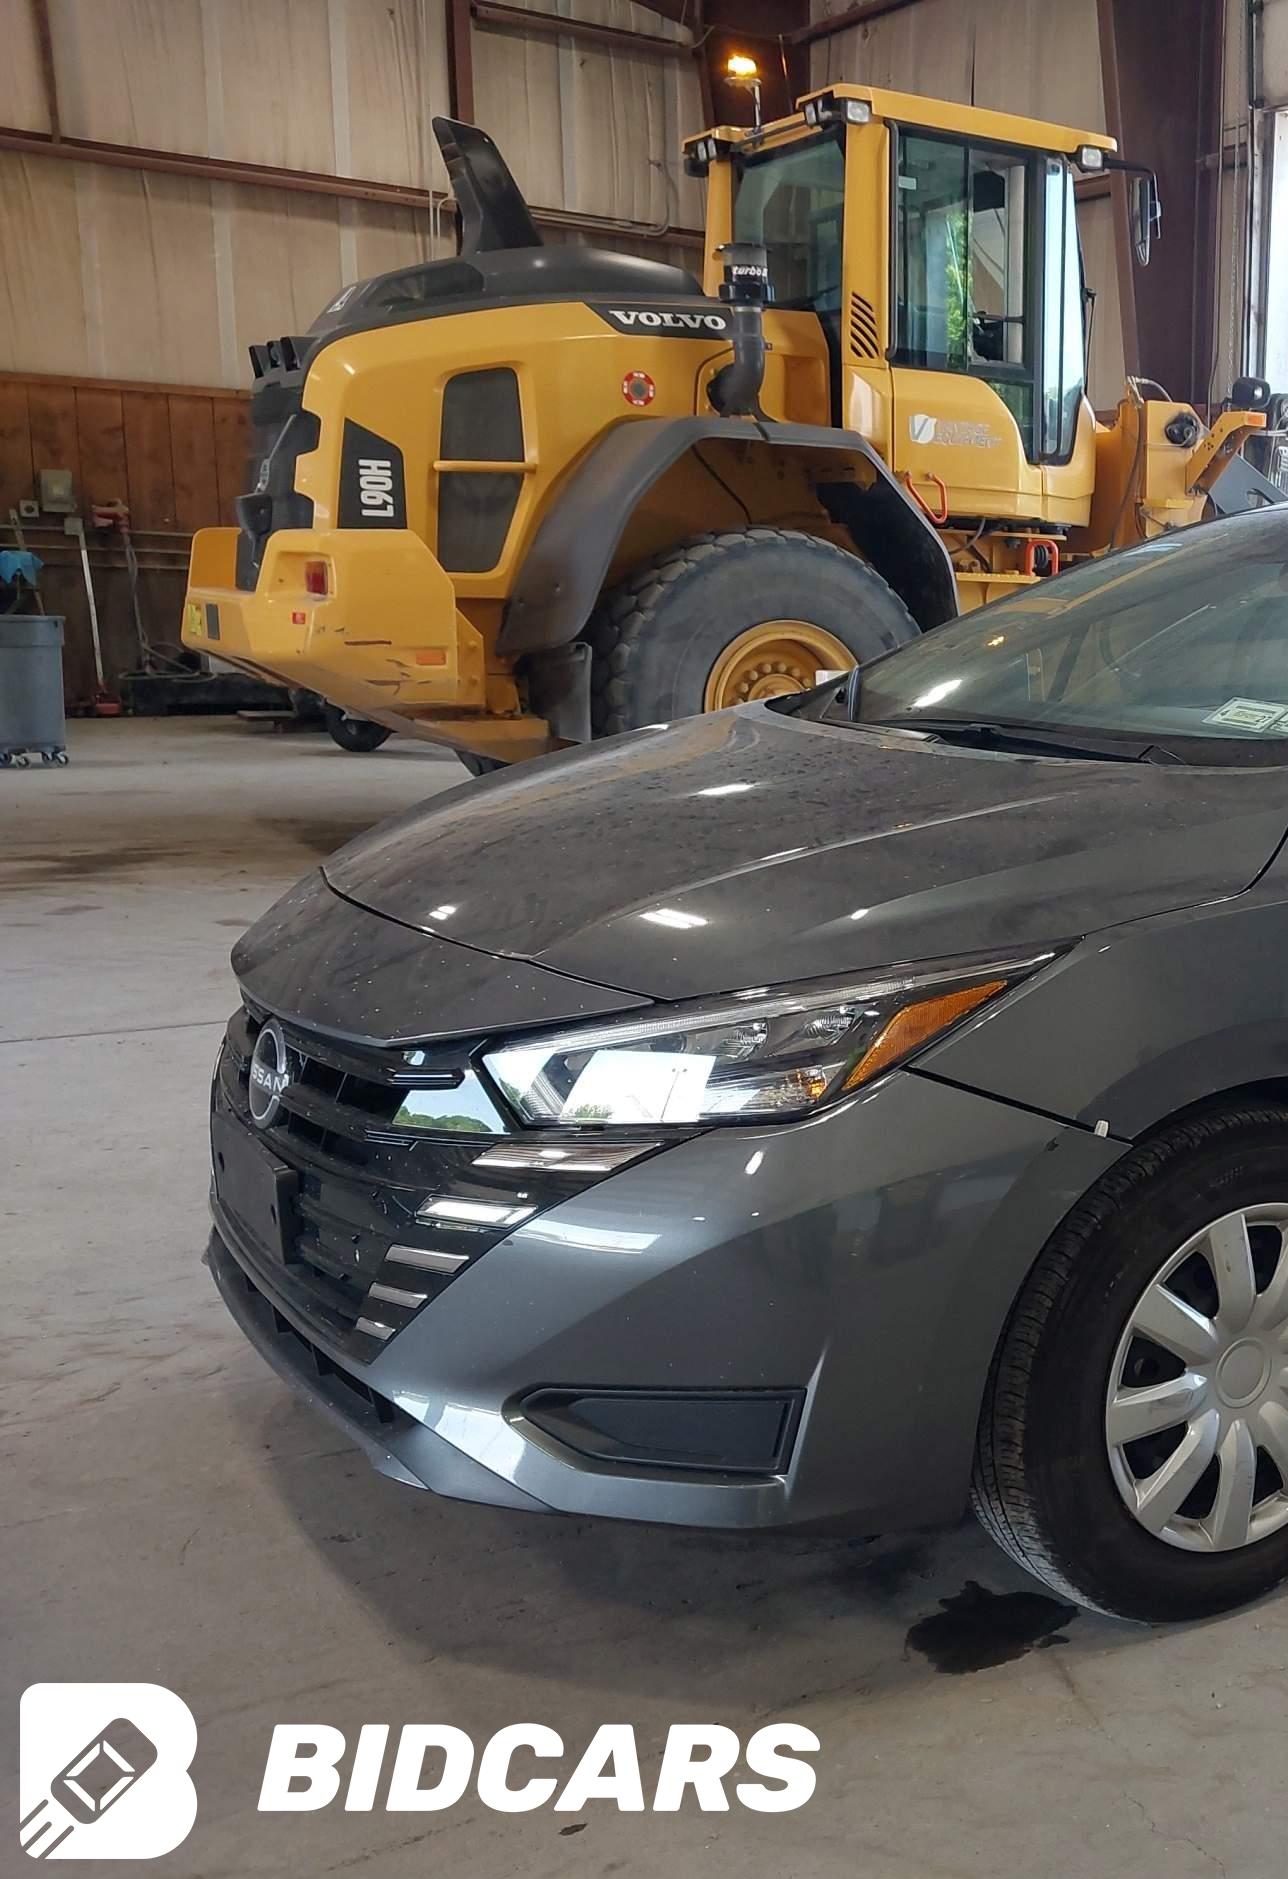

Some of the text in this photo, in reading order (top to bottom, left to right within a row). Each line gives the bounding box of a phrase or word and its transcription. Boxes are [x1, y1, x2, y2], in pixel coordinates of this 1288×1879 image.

[608, 310, 727, 331] VOLVO
[358, 458, 394, 517] L90H
[251, 1063, 289, 1093] SSAN
